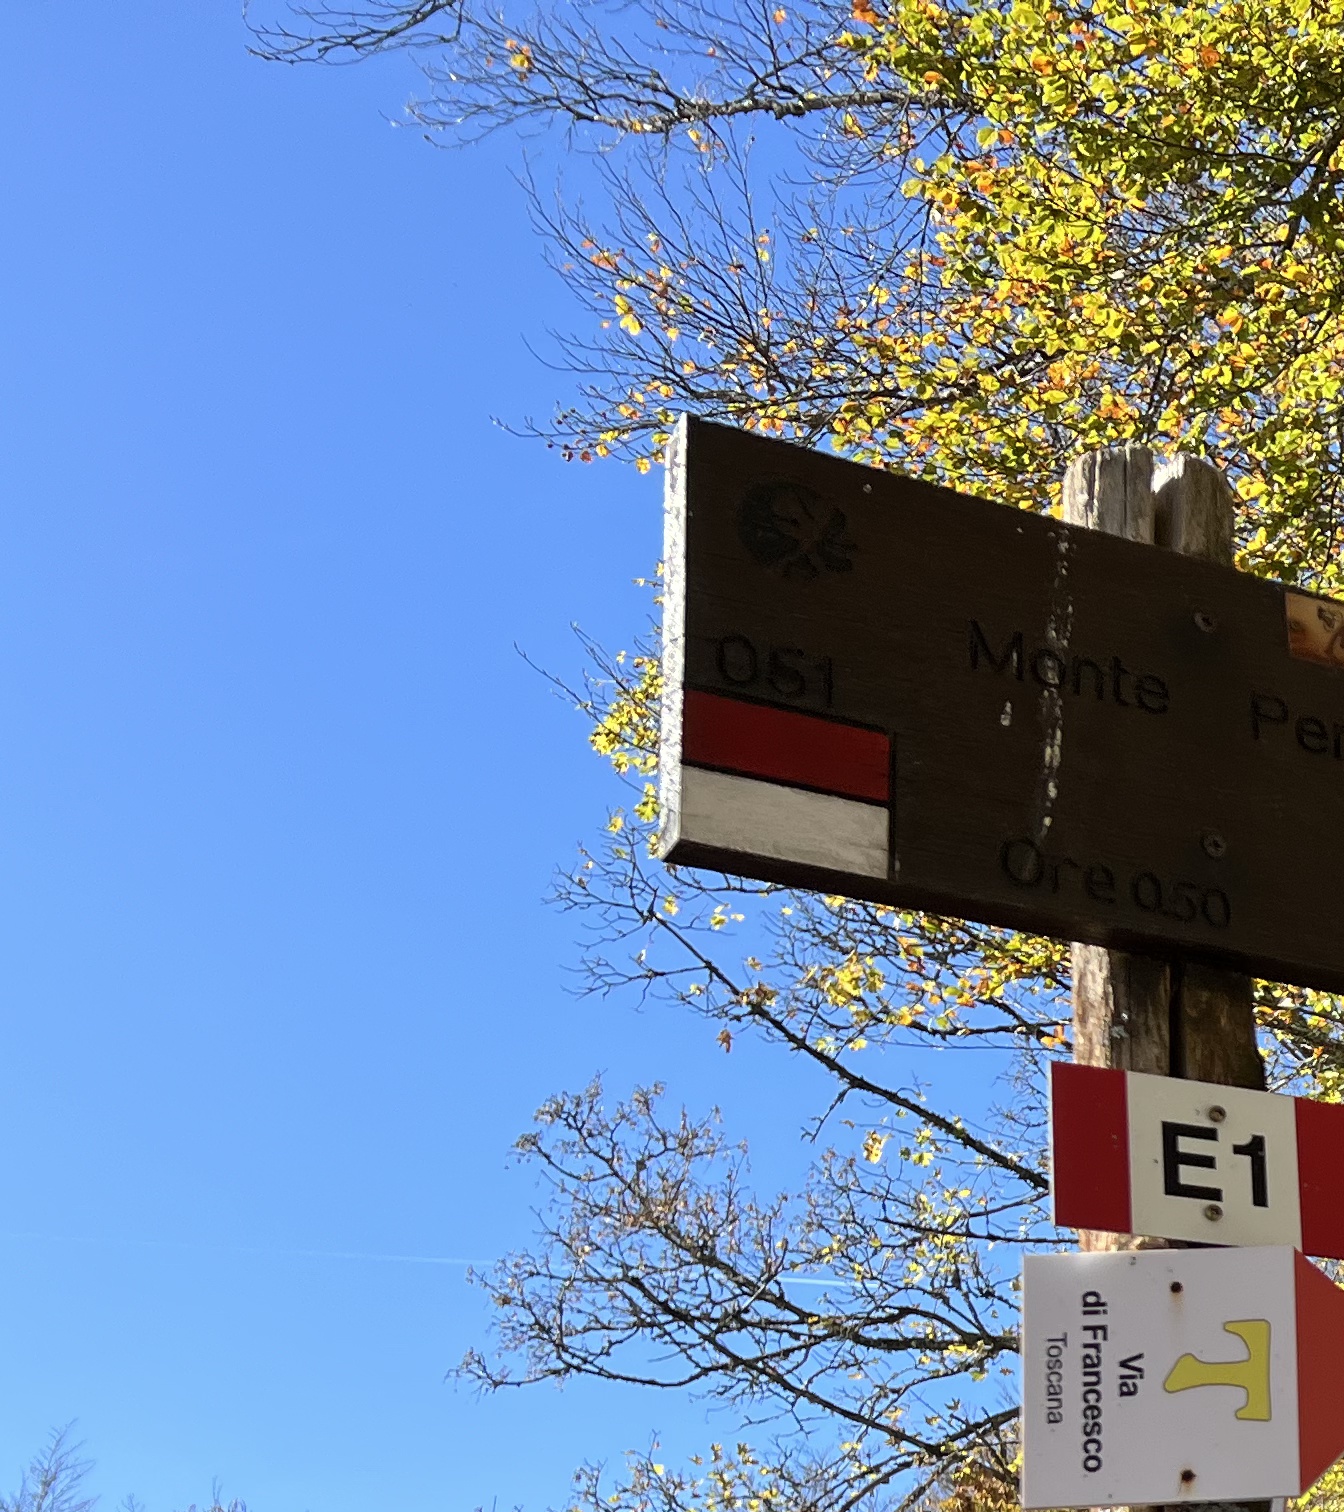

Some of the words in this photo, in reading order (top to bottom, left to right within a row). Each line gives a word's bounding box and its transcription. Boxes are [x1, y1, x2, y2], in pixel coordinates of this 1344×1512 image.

[716, 634, 834, 707] 051
[967, 619, 1171, 715] Monte
[998, 837, 1116, 905] Ore
[1160, 1120, 1270, 1208] E1
[1081, 1289, 1109, 1317] di
[1045, 1332, 1069, 1426] Toscana
[1081, 1323, 1109, 1474] Francesco
[1117, 1351, 1146, 1399] Via
